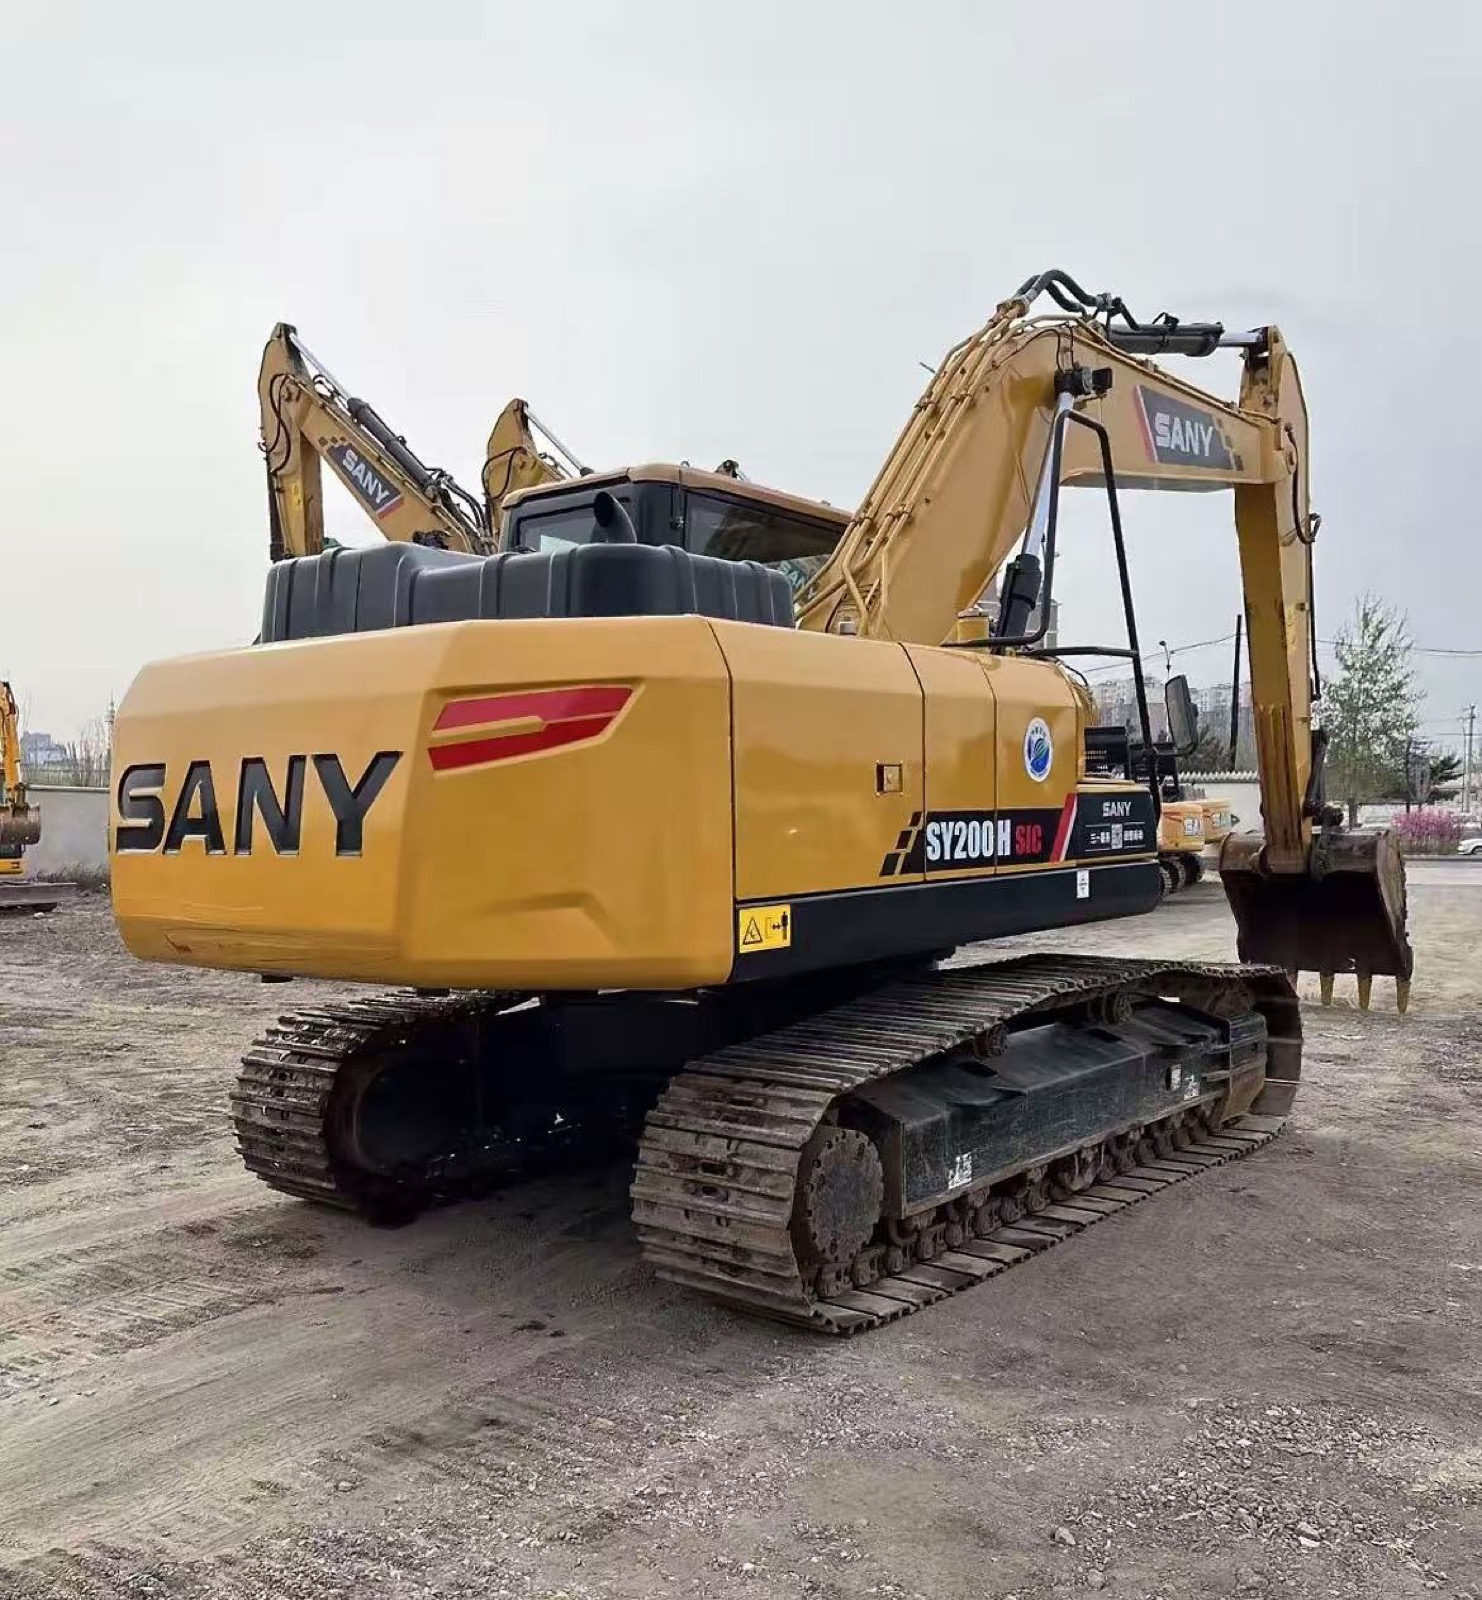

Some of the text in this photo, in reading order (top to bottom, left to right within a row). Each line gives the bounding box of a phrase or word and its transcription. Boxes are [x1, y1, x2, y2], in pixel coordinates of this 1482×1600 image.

[1155, 412, 1214, 457] SANY
[342, 449, 390, 504] SANY
[116, 750, 404, 857] SANY
[1102, 801, 1132, 817] SANY
[926, 819, 1042, 861] SY200H SIC
